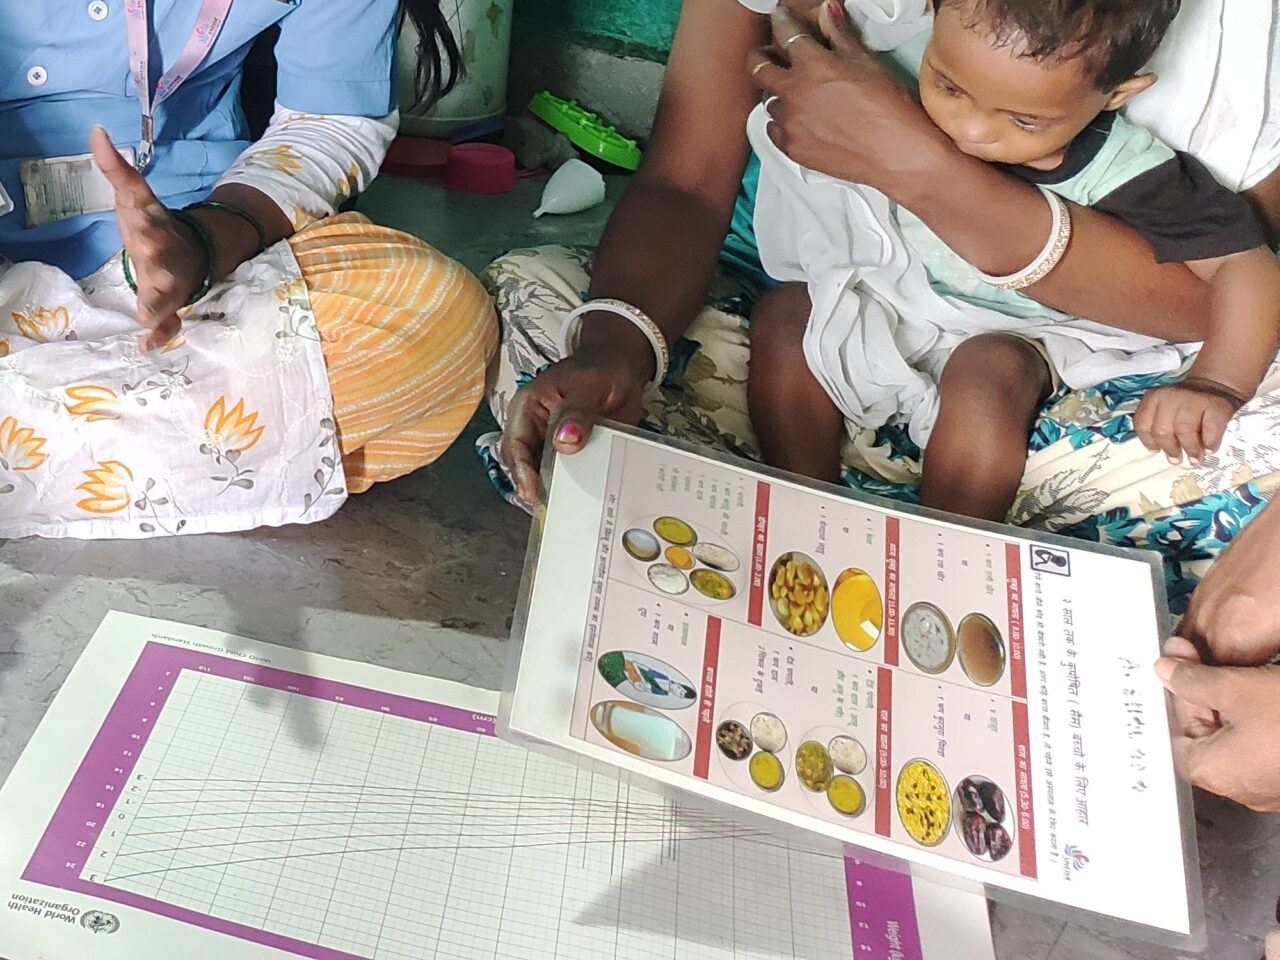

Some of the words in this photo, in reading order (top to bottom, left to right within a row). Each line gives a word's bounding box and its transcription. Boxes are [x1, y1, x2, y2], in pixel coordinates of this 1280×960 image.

[1062, 607, 1073, 626] साल
[151, 633, 191, 647] Standards
[1063, 629, 1074, 645] तक
[192, 640, 224, 655] Growth
[225, 648, 247, 659] Child
[1065, 648, 1077, 657] के
[1059, 661, 1080, 696] कुपोषित
[1074, 762, 1086, 771] के
[1074, 776, 1089, 795] लिए
[1075, 797, 1088, 825] आहार
[100, 850, 108, 858] 2
[89, 873, 97, 882] 3
[7, 900, 42, 916] Health
[11, 892, 81, 916] Organization
[44, 909, 76, 924] World
[885, 920, 902, 949] Weight
